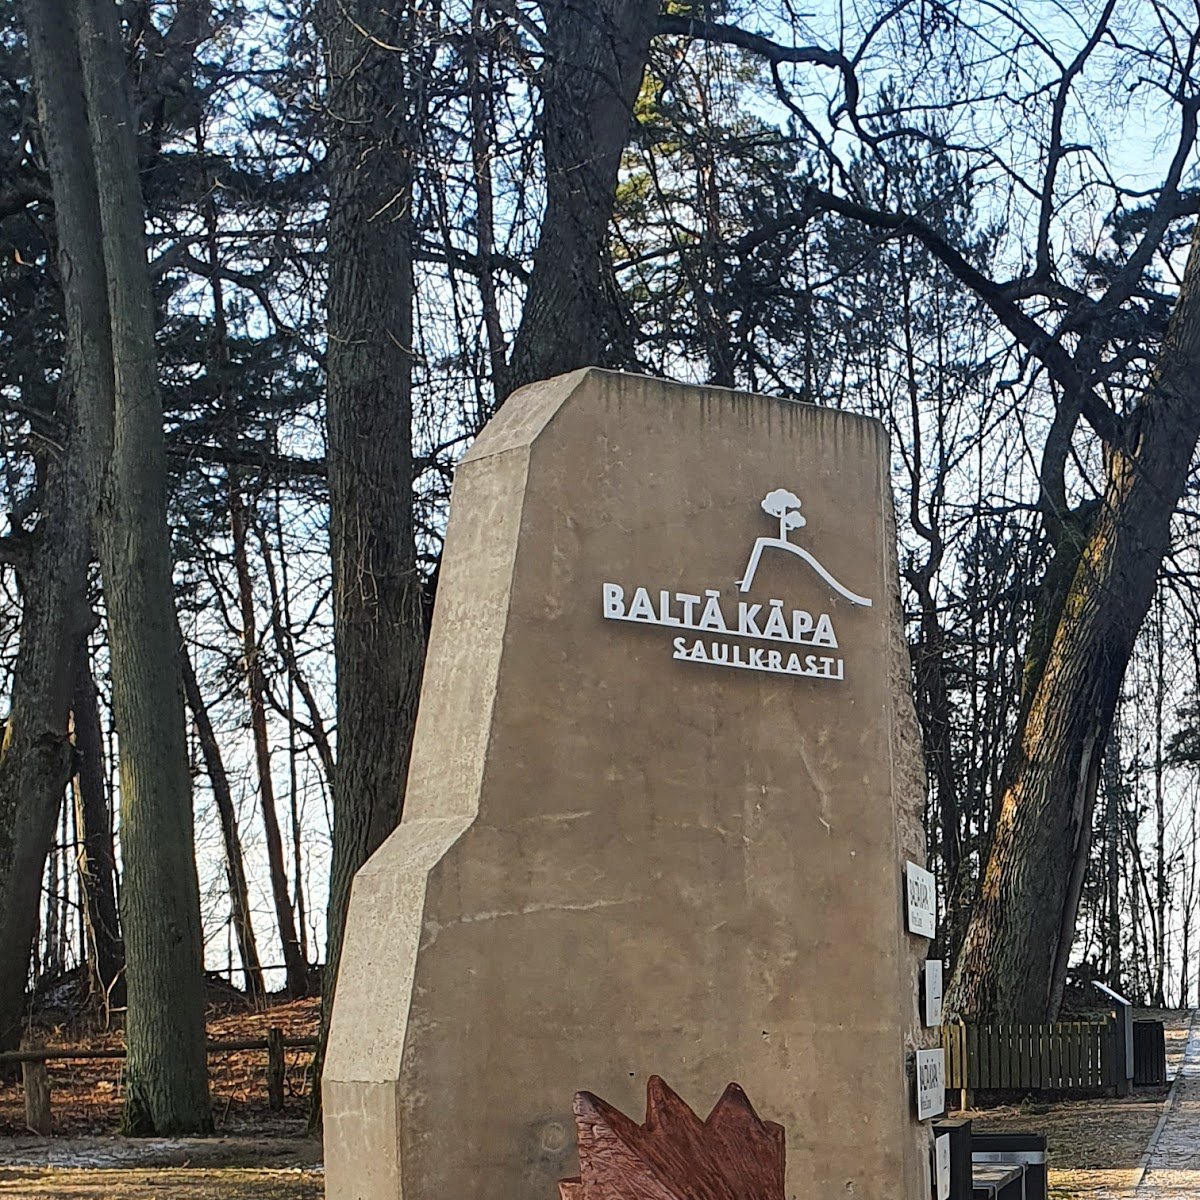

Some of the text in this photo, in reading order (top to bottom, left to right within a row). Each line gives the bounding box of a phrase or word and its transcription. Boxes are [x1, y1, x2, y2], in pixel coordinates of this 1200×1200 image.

[602, 582, 839, 649] BALTĀ KĀPA
[672, 637, 845, 681] SAULKRASTI
